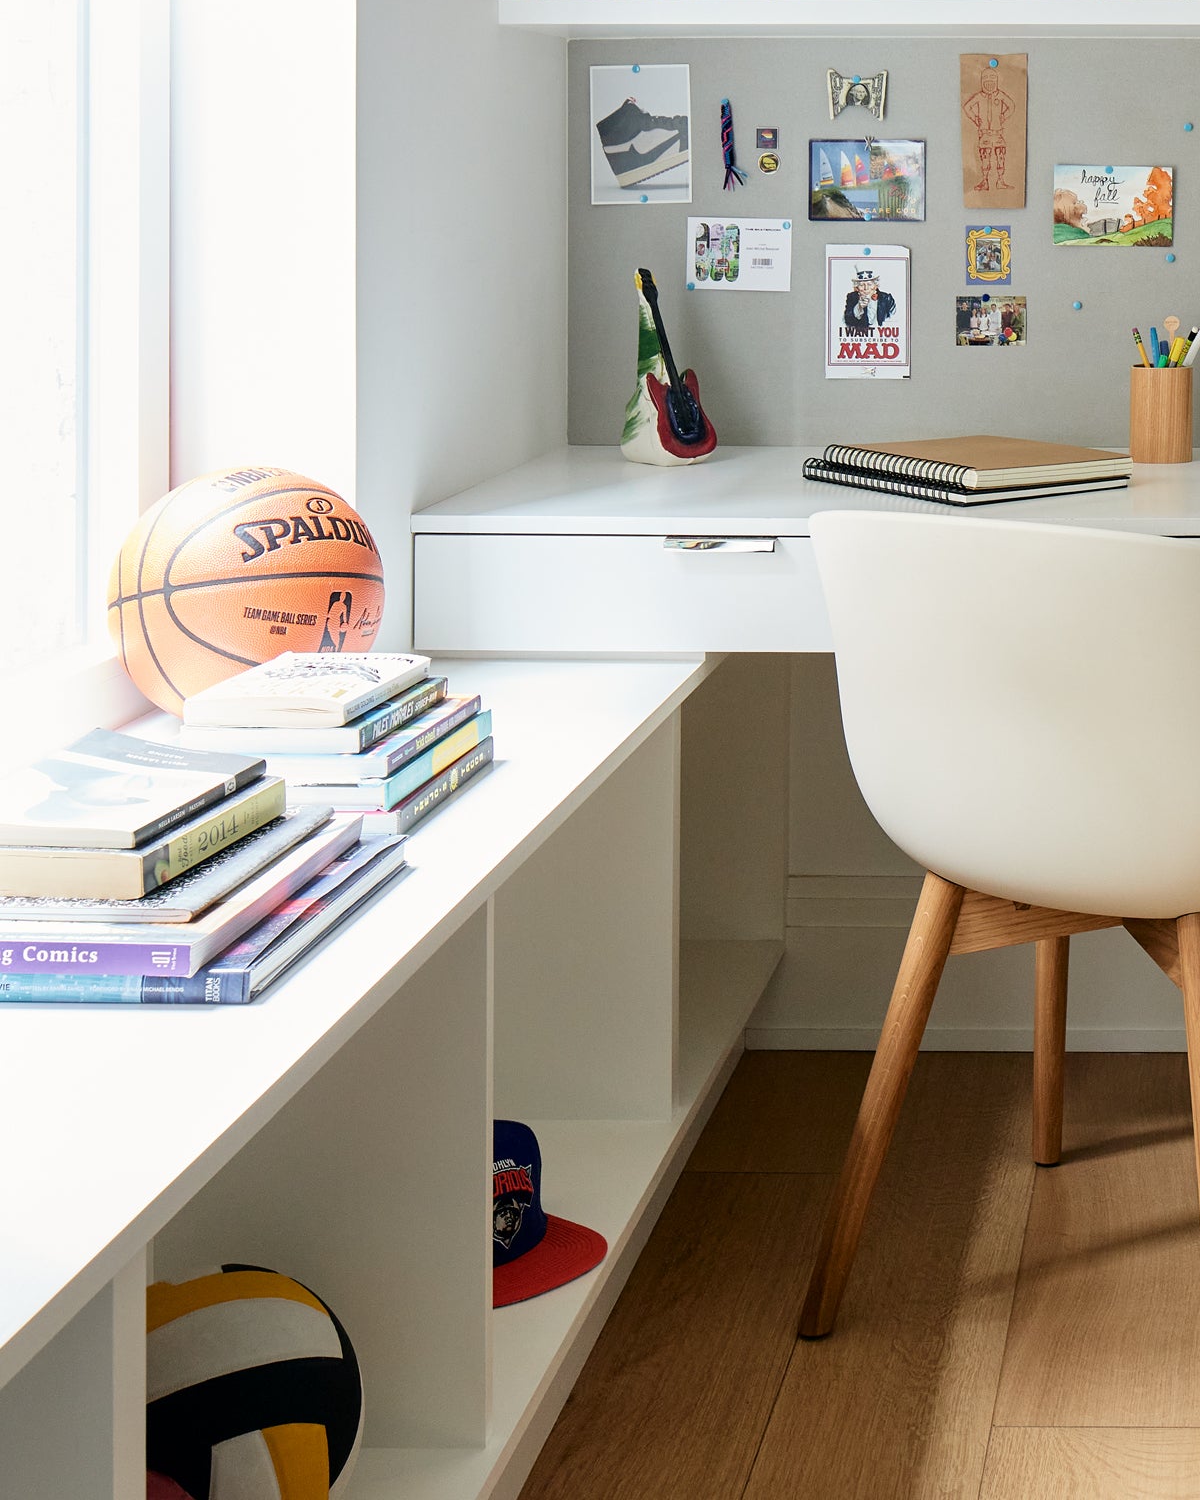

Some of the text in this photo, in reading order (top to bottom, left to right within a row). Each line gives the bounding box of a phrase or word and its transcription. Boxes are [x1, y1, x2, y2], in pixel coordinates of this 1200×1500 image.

[1081, 169, 1125, 192] happy
[1094, 187, 1120, 208] fall
[839, 326, 900, 338] I WANT YOU
[837, 342, 900, 360] MAD
[233, 515, 381, 564] SPALDIN
[243, 606, 318, 626] TEAM GAME BALL SERIES
[269, 625, 288, 636] @NBA
[424, 728, 436, 744] chef
[460, 752, 484, 777] TACOS
[198, 813, 239, 852] 2014
[22, 945, 98, 963] Comics
[205, 977, 213, 1002] TITAN
[212, 977, 221, 1002] BOOKS
